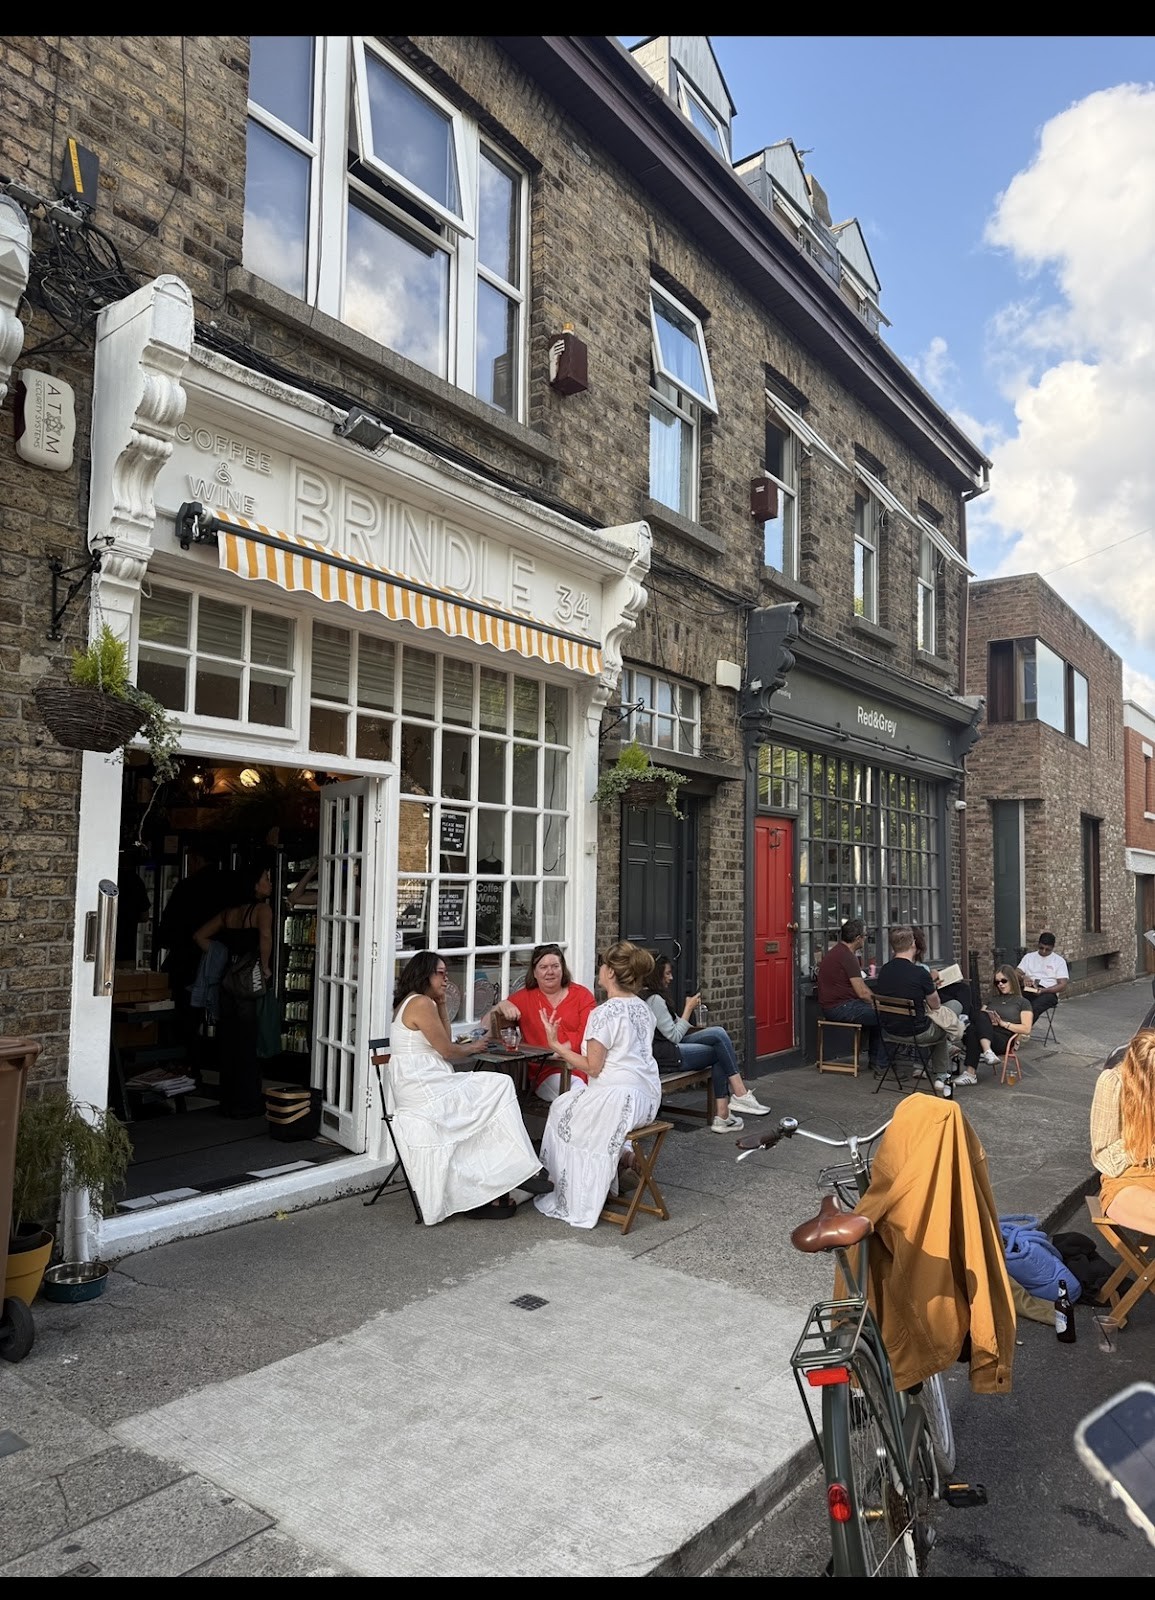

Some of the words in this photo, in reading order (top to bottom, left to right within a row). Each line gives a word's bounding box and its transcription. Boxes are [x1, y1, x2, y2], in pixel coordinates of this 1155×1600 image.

[34, 379, 43, 414] SECURITY
[33, 415, 42, 448] SYSTEMS
[175, 421, 272, 475] COFFEE
[215, 462, 233, 485] &
[187, 474, 255, 518] WINE
[290, 458, 536, 616] BRINDLE
[555, 582, 591, 630] 34
[857, 706, 897, 738] Red&Grey
